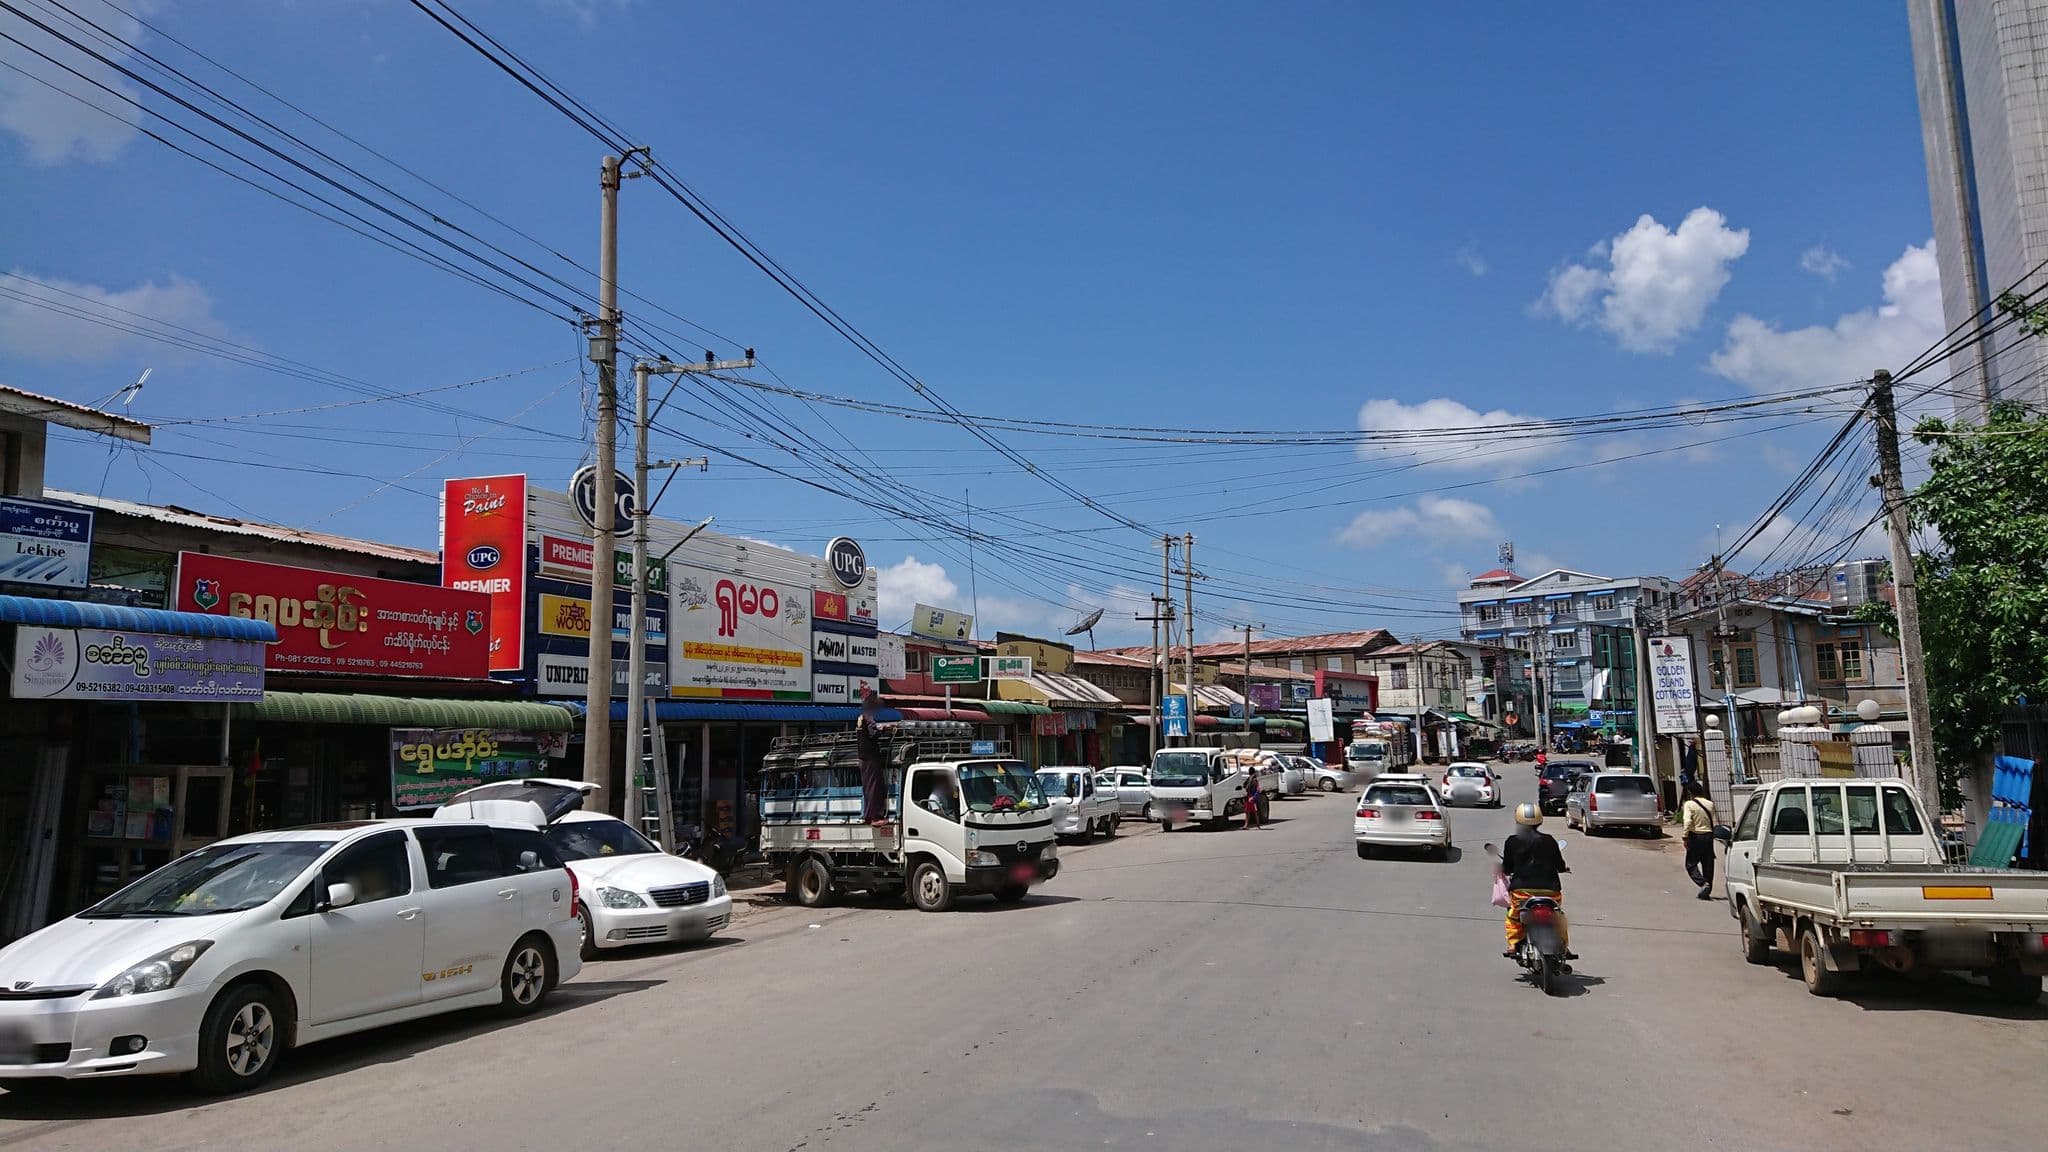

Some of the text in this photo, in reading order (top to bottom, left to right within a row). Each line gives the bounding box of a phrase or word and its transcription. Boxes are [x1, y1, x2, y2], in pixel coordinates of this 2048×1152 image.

[463, 494, 505, 516] Paint
[16, 541, 66, 558] Lekise
[552, 543, 595, 565] PREMIE
[470, 551, 497, 564] UPG
[834, 550, 862, 576] UPG
[556, 616, 591, 631] WOOD
[616, 612, 662, 632] PROTIVE
[851, 645, 877, 657] MASTER
[1656, 666, 1686, 676] GOLDEN
[817, 684, 845, 694] UNITEX
[1658, 678, 1685, 687] ISLAND
[1655, 689, 1692, 700] COTTAGES
